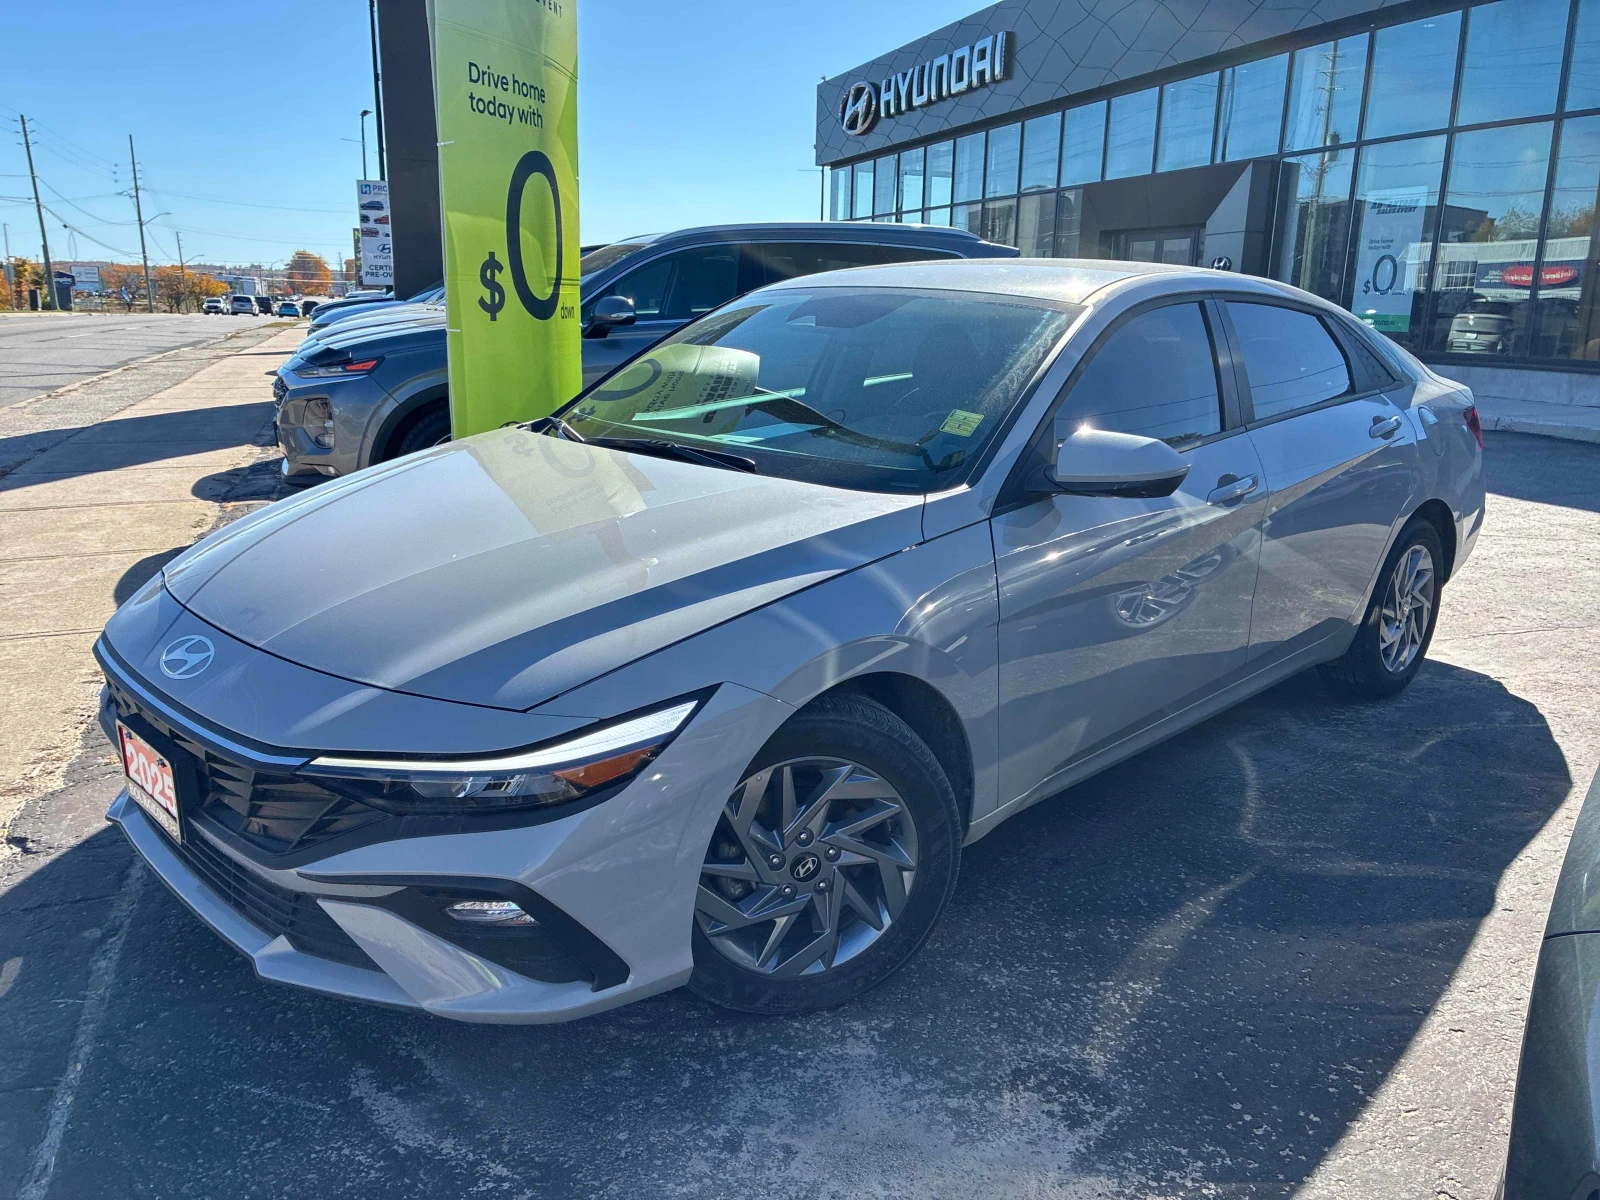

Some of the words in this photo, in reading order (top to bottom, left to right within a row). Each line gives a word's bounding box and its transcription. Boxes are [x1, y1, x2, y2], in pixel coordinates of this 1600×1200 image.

[536, 0, 562, 18] VENT
[468, 61, 509, 92] Drive
[512, 73, 546, 104] home
[880, 31, 1006, 118] HYUNDAI
[468, 92, 515, 125] today
[517, 105, 543, 129] with
[477, 251, 506, 322] $
[505, 150, 563, 321] 0
[560, 302, 575, 320] down
[126, 742, 177, 819] 2025
